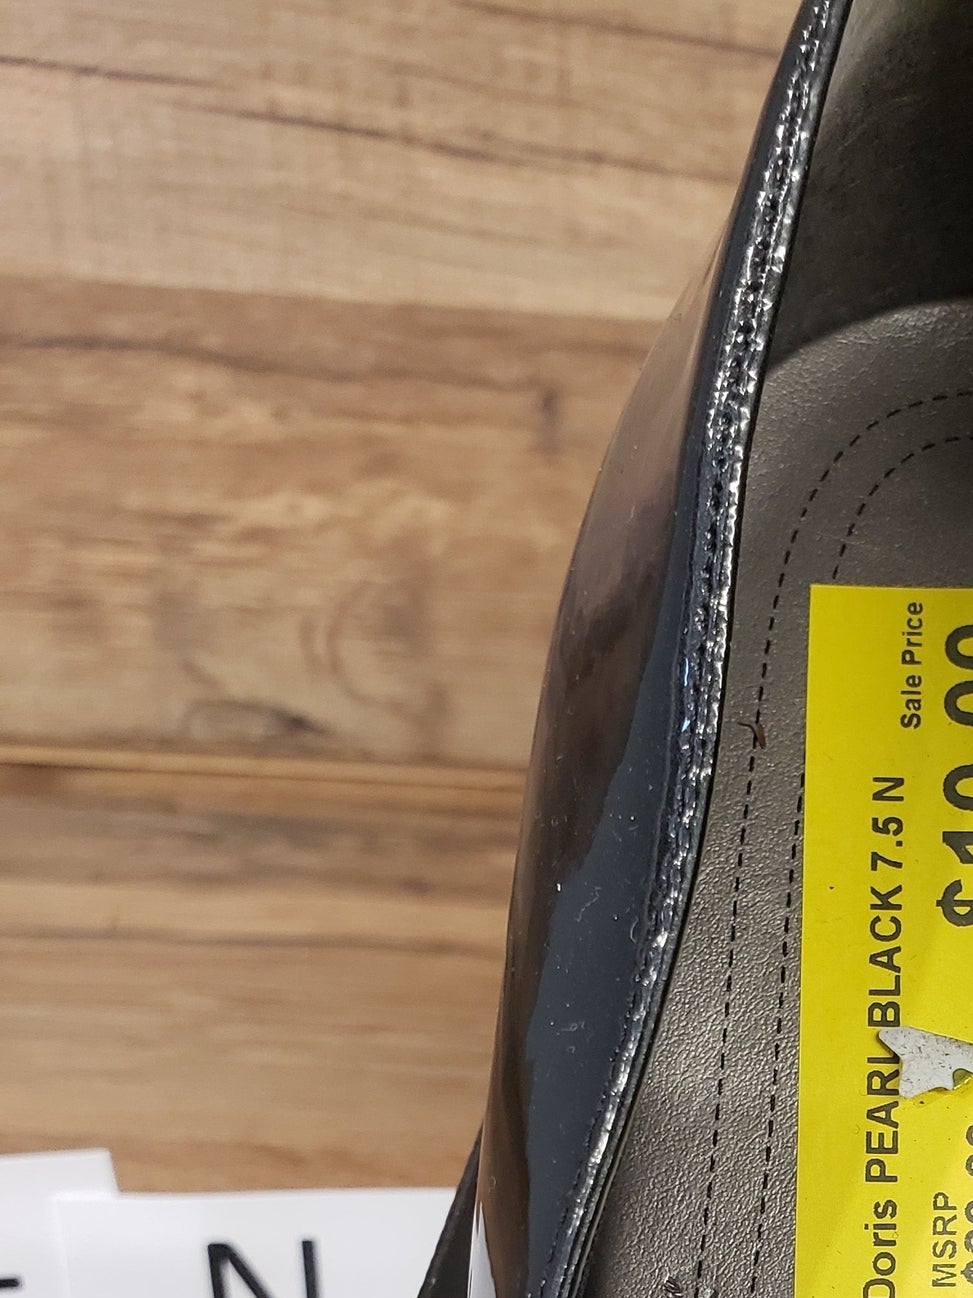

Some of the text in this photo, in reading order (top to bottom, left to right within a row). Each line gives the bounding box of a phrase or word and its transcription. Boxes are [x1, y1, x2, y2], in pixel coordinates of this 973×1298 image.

[899, 601, 924, 730] Sale Price
[870, 816, 904, 872] 7.5
[871, 776, 905, 802] N
[868, 884, 903, 1027] BLACK
[864, 1049, 900, 1183] PEARL
[931, 1191, 958, 1288] MSRP
